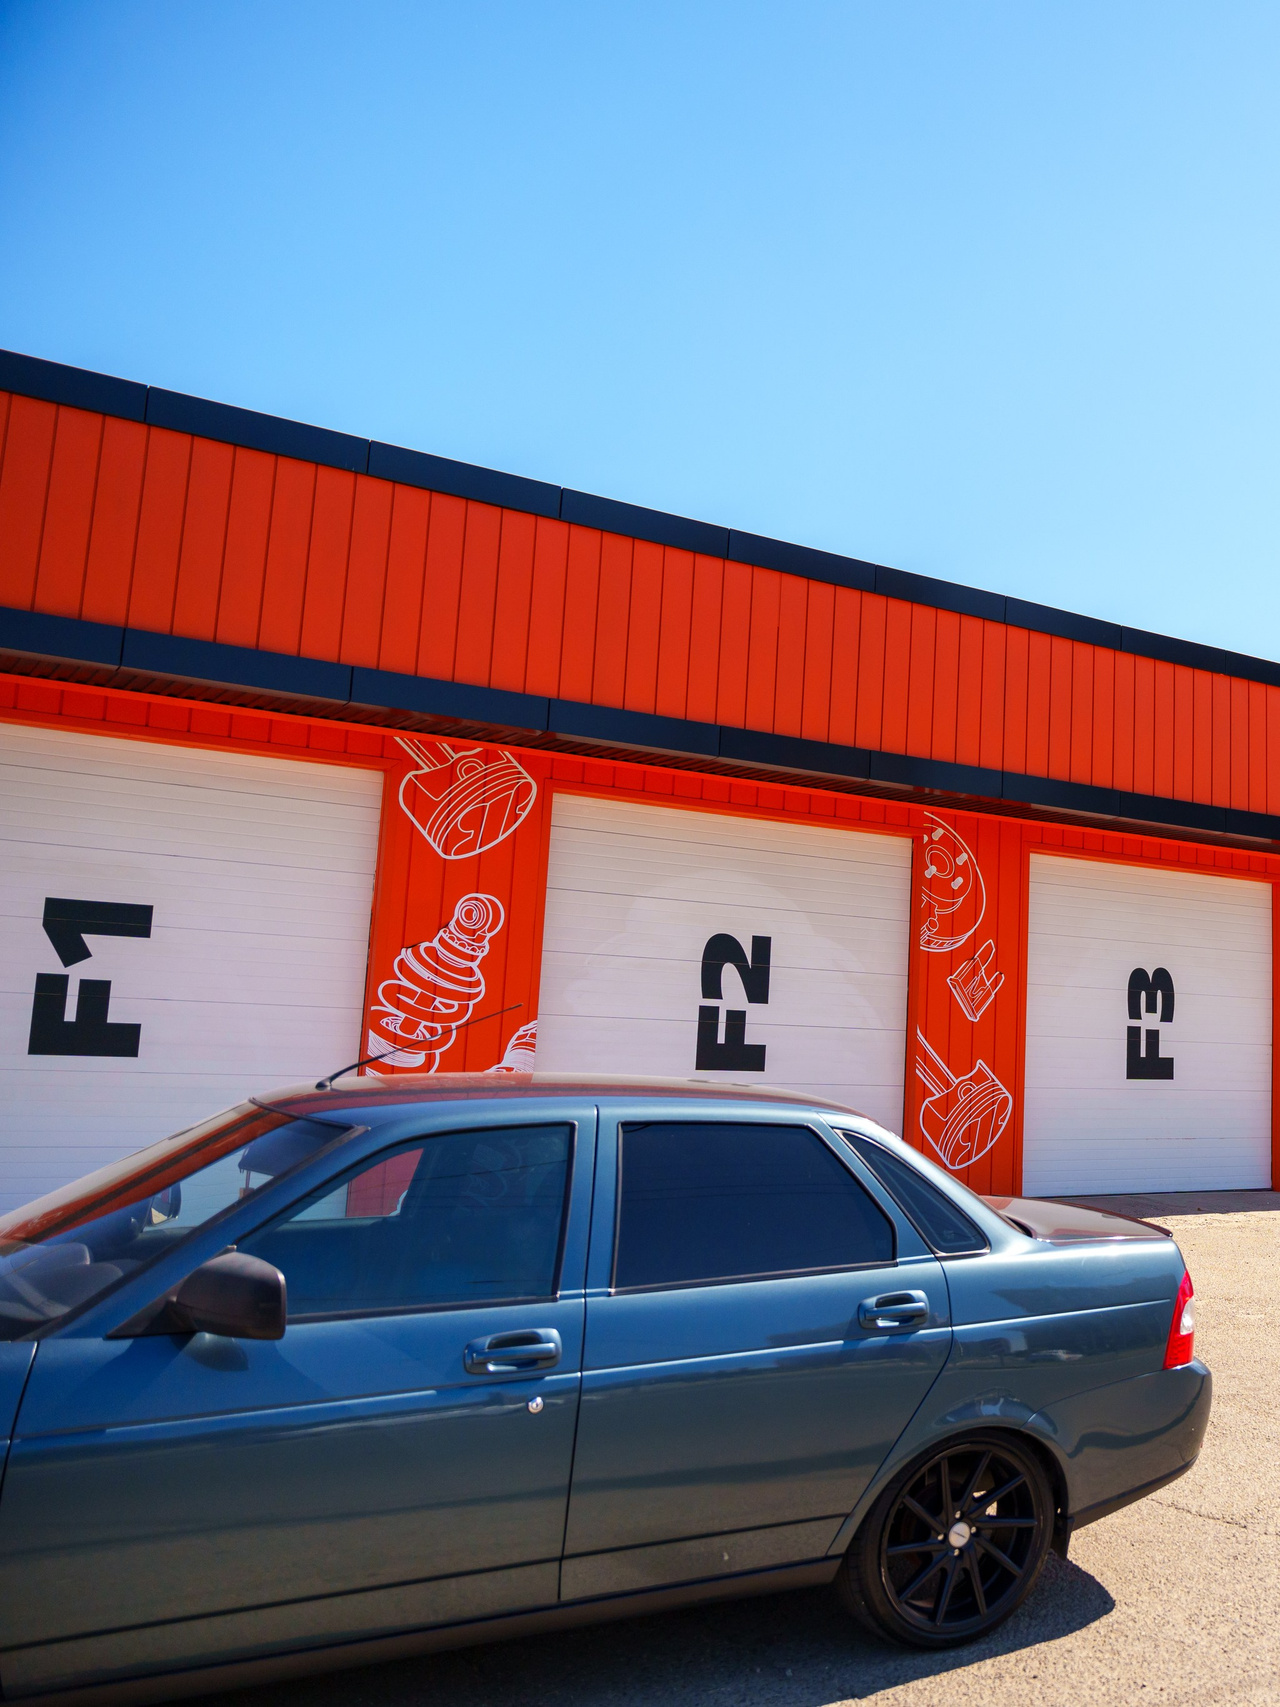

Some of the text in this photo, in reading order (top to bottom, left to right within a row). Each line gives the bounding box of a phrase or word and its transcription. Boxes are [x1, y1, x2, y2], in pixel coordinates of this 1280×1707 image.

[28, 897, 153, 1058] F1
[695, 933, 772, 1072] F2
[1126, 967, 1175, 1080] F3
